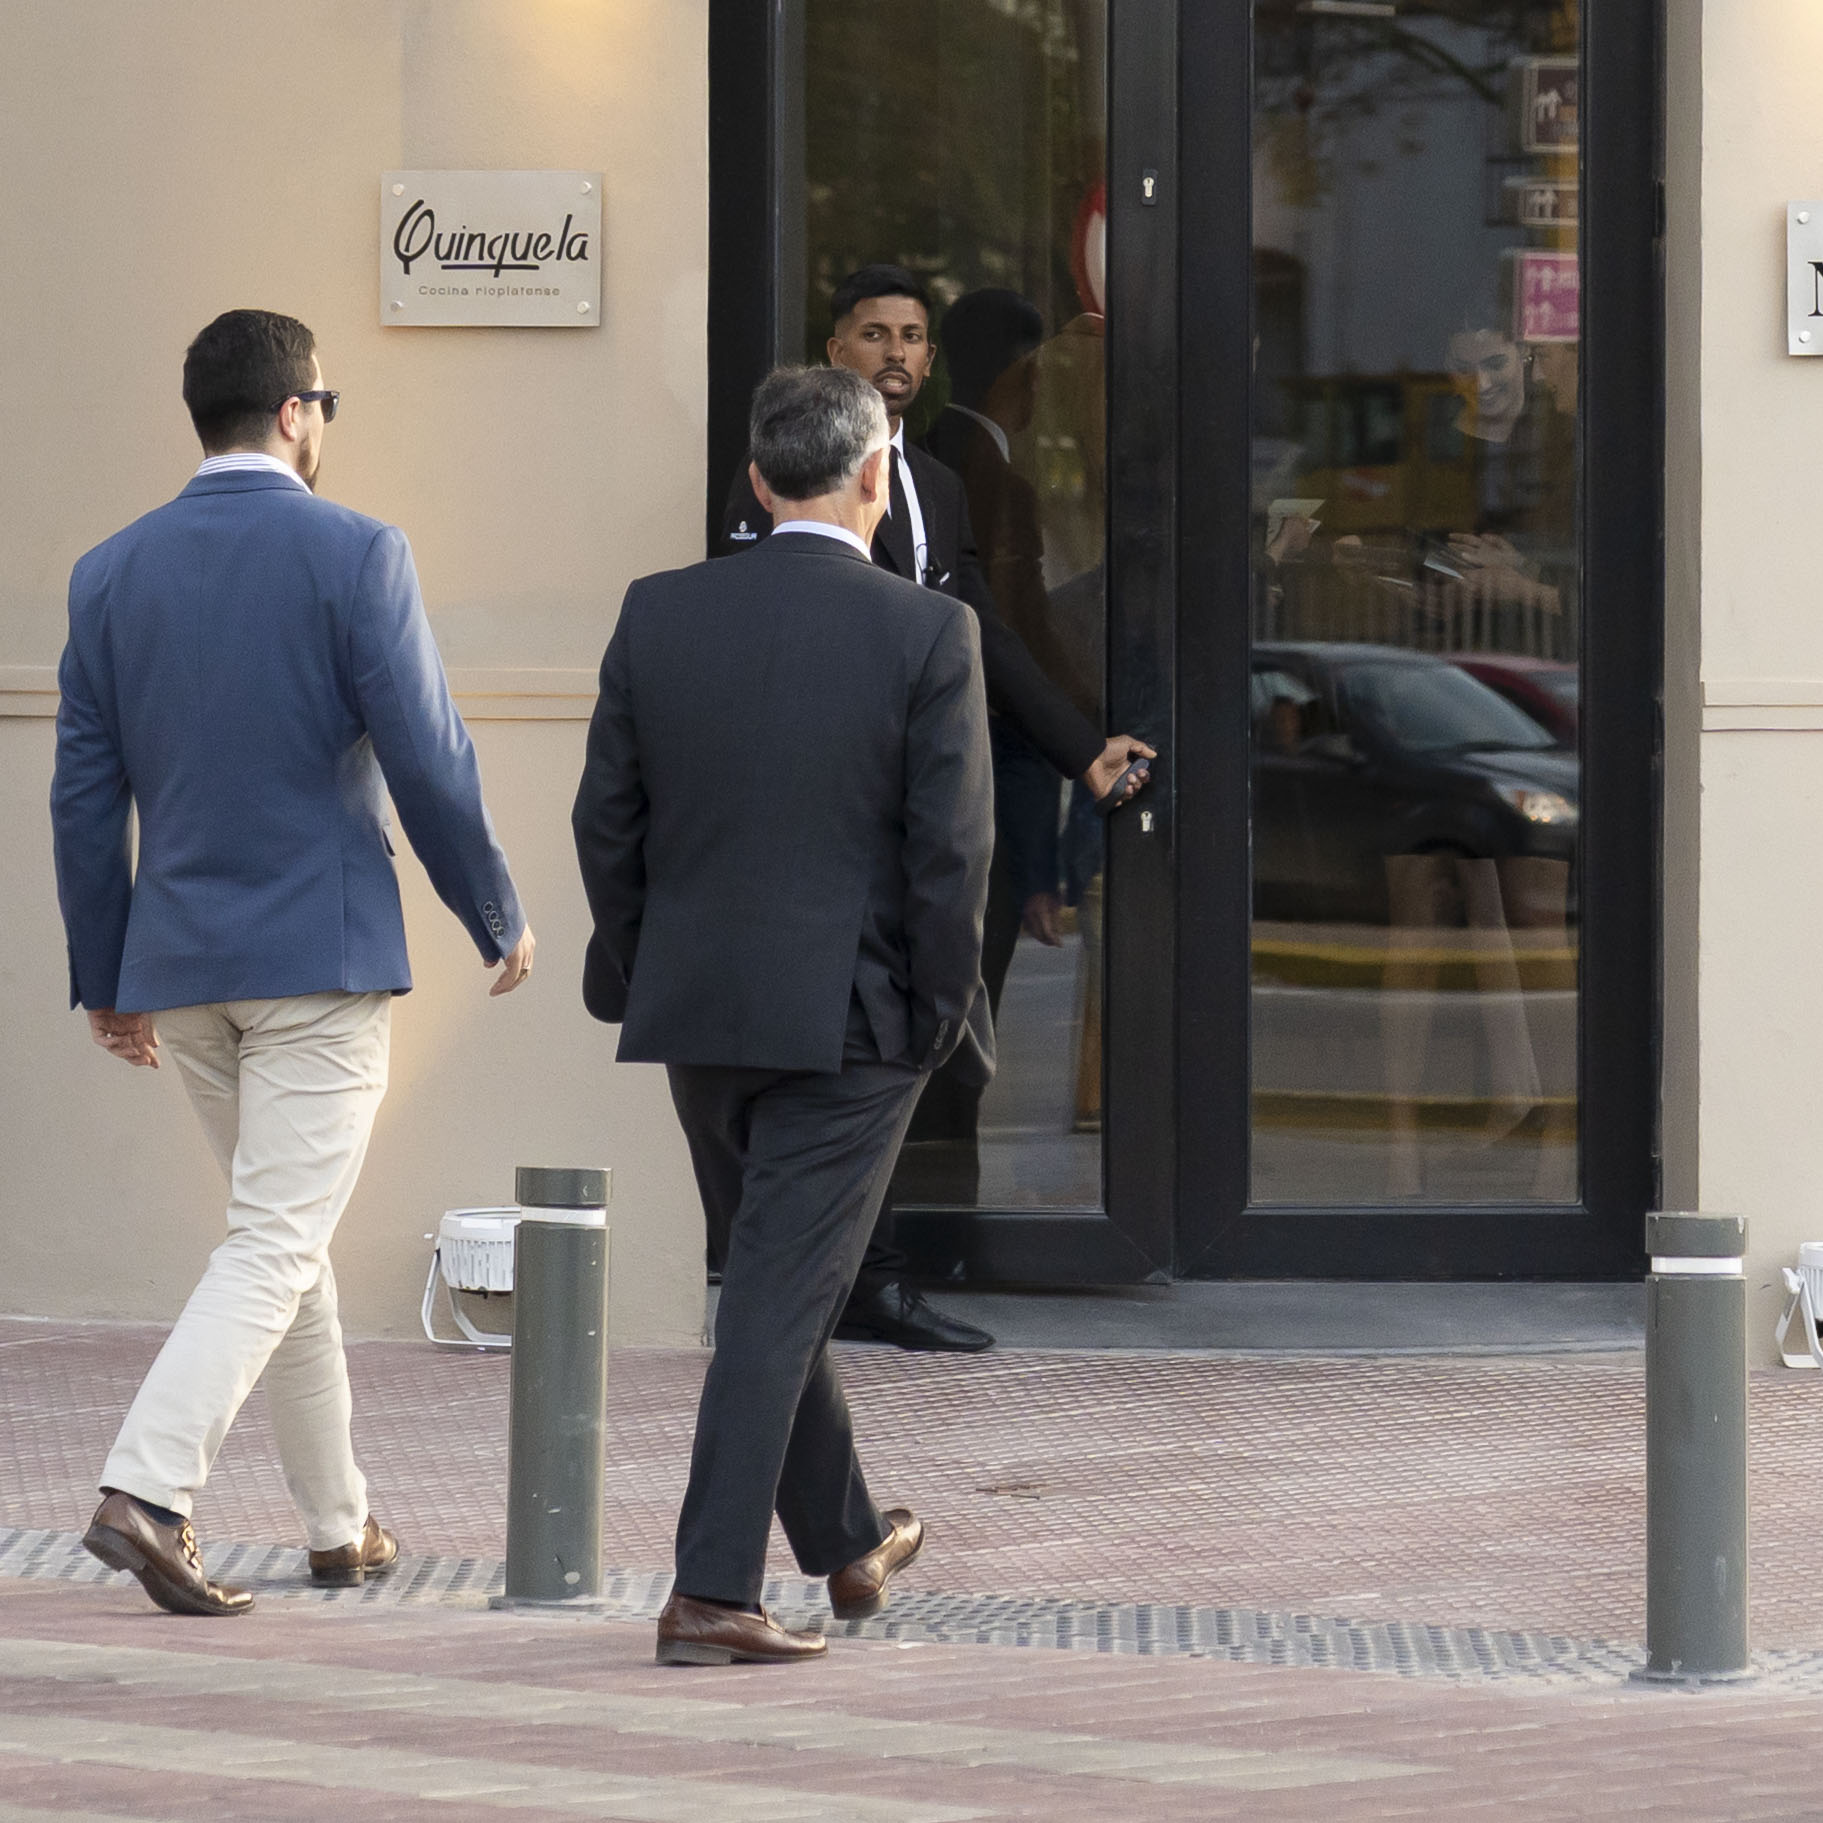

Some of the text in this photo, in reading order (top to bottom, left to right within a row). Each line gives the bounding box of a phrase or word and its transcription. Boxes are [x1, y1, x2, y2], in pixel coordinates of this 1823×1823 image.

[393, 199, 589, 279] Quinquela
[418, 285, 561, 298] Cocina rioplatense
